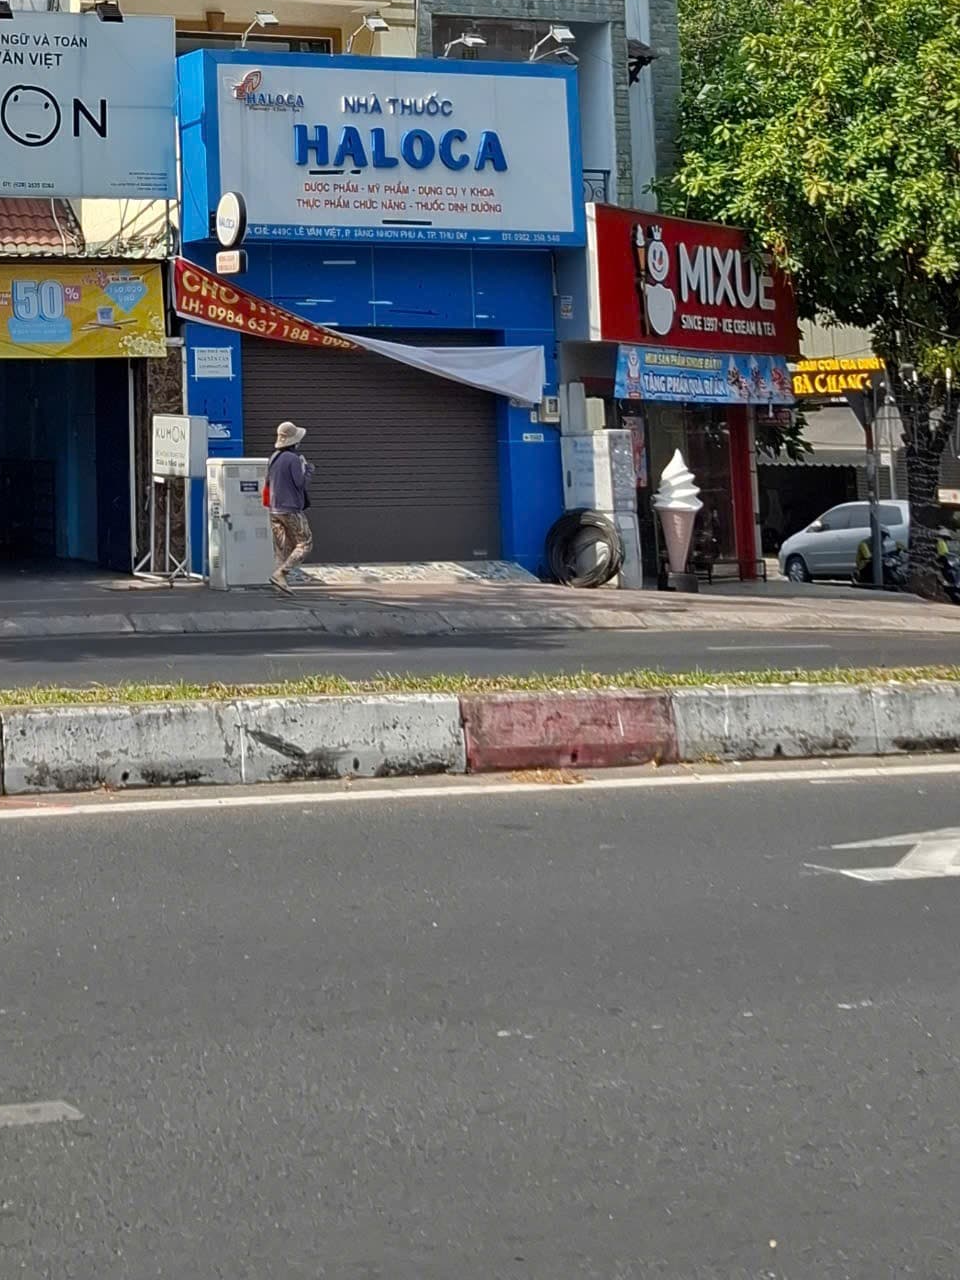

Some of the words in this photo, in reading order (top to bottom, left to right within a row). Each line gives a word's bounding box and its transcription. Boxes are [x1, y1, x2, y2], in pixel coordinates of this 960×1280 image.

[1, 31, 30, 47] NGỮ
[32, 31, 50, 47] VÀ
[54, 33, 88, 48] TOÁN
[30, 51, 63, 69] VIỆT
[246, 93, 304, 107] HALOCA
[342, 93, 382, 115] NHÀ
[388, 92, 453, 117] THUỐC
[294, 124, 508, 171] HALOCA
[304, 182, 330, 194] DƯỢC
[333, 180, 358, 193] PHẨM
[368, 182, 380, 194] MỸ
[384, 181, 409, 194] PHẨM
[418, 186, 442, 197] DỤNG
[446, 187, 458, 197] CỤ
[461, 188, 467, 196] Y
[470, 188, 495, 197] KHOA
[296, 198, 321, 210] THỰC
[324, 195, 350, 209] PHẨM
[353, 198, 377, 210] CHỨC
[381, 199, 406, 211] NĂNG
[415, 198, 445, 212] THUỐC
[294, 225, 304, 235] LÊ
[679, 242, 776, 310] MIXUE
[181, 295, 204, 314] LH:
[208, 305, 244, 327] 0984
[248, 316, 277, 336] 637
[283, 325, 310, 342] 188
[681, 314, 702, 331] SINCE
[703, 317, 718, 333] 1997
[722, 318, 733, 334] ICE
[734, 319, 756, 336] CREAM
[763, 321, 777, 337] TEA
